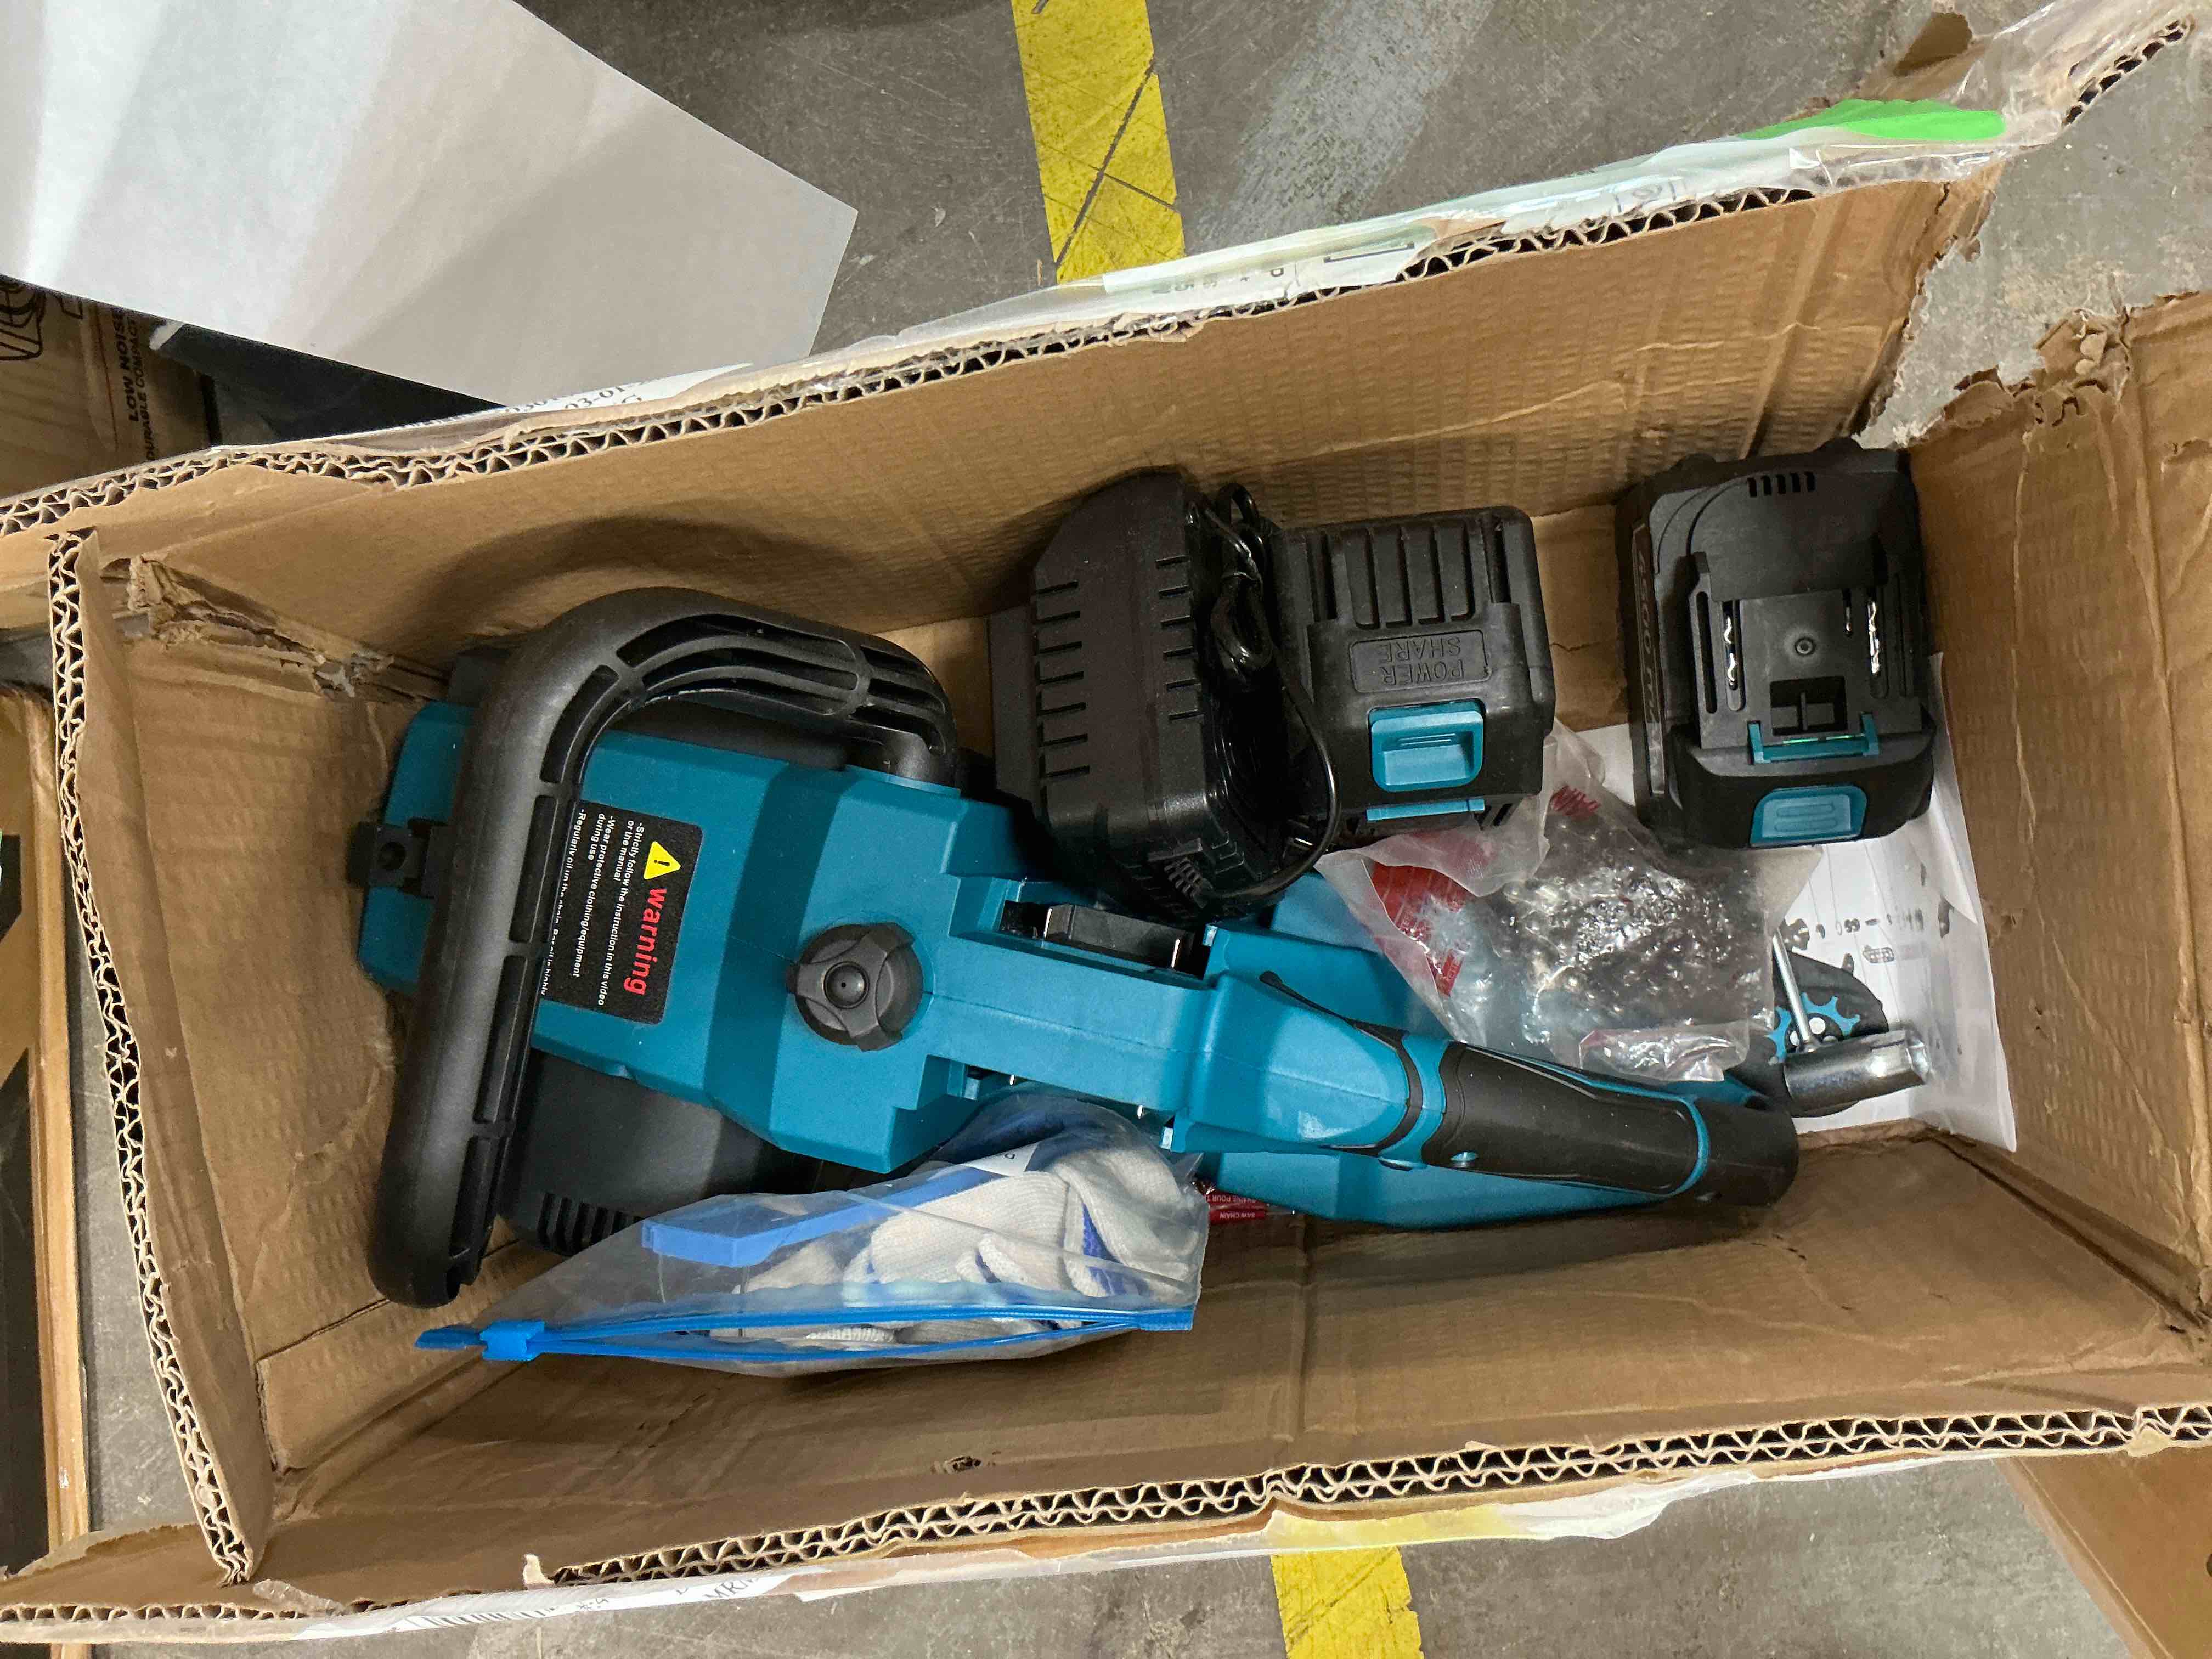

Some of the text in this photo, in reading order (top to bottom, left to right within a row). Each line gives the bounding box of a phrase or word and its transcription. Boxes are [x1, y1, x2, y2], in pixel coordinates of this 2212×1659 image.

[123, 376, 139, 422] LOW
[127, 315, 156, 461] DURABLE COMPACT
[1378, 636, 1461, 663] SHARE
[1379, 658, 1464, 685] POWER
[569, 809, 586, 856] -Regularly
[588, 814, 606, 860] during use
[613, 820, 634, 881] or the manual
[572, 816, 616, 977] -Wear protective clothing/equipment
[598, 822, 644, 1005] -Strictly follow the instruction in this video
[623, 888, 667, 996] warning
[1220, 1211, 1240, 1219] CHAIN
